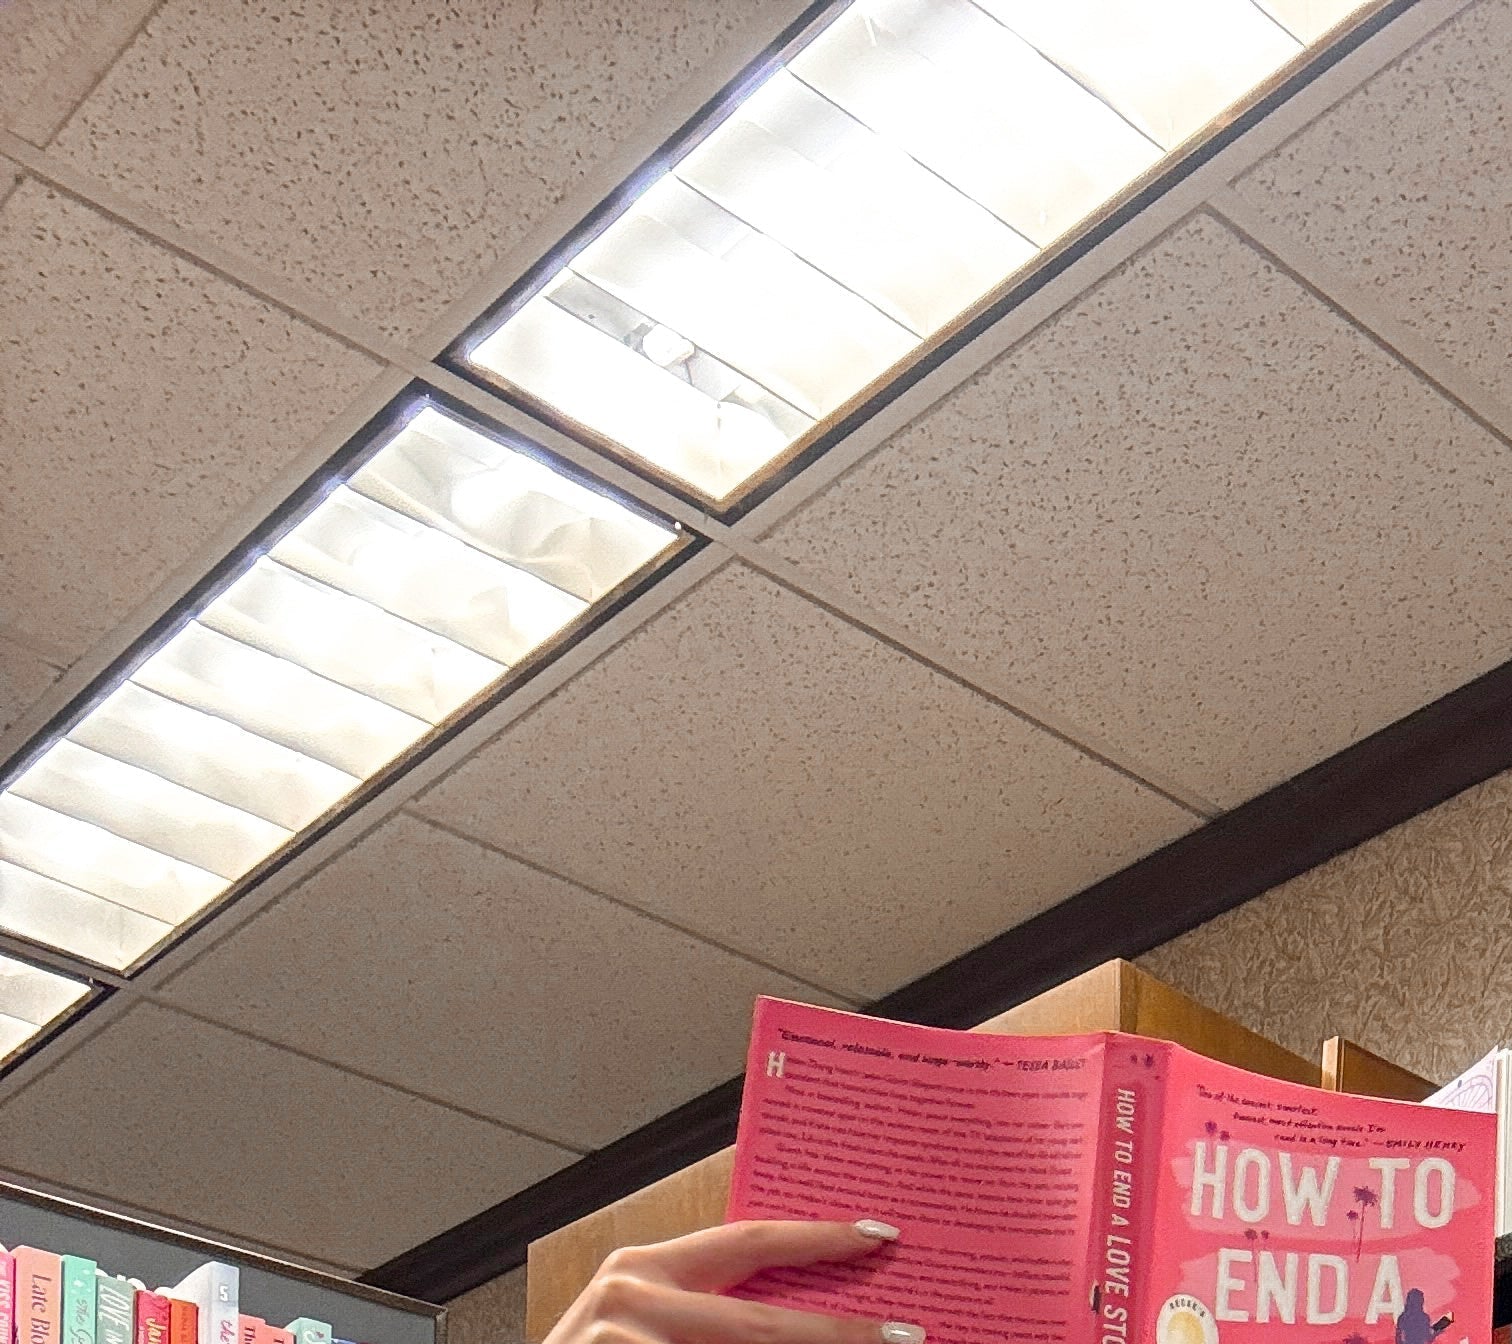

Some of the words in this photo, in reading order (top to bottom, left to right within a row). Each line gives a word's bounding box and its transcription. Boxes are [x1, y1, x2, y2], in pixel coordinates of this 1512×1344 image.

[1115, 1088, 1136, 1134] HOW
[1113, 1139, 1134, 1165] TO
[1112, 1168, 1132, 1207] END
[1191, 1141, 1341, 1226] HOW
[1368, 1157, 1456, 1229] TO
[1111, 1213, 1131, 1227] A
[1104, 1235, 1131, 1299] LOVE
[1215, 1247, 1348, 1324] END
[1364, 1254, 1404, 1325] A
[30, 1273, 52, 1312] Late
